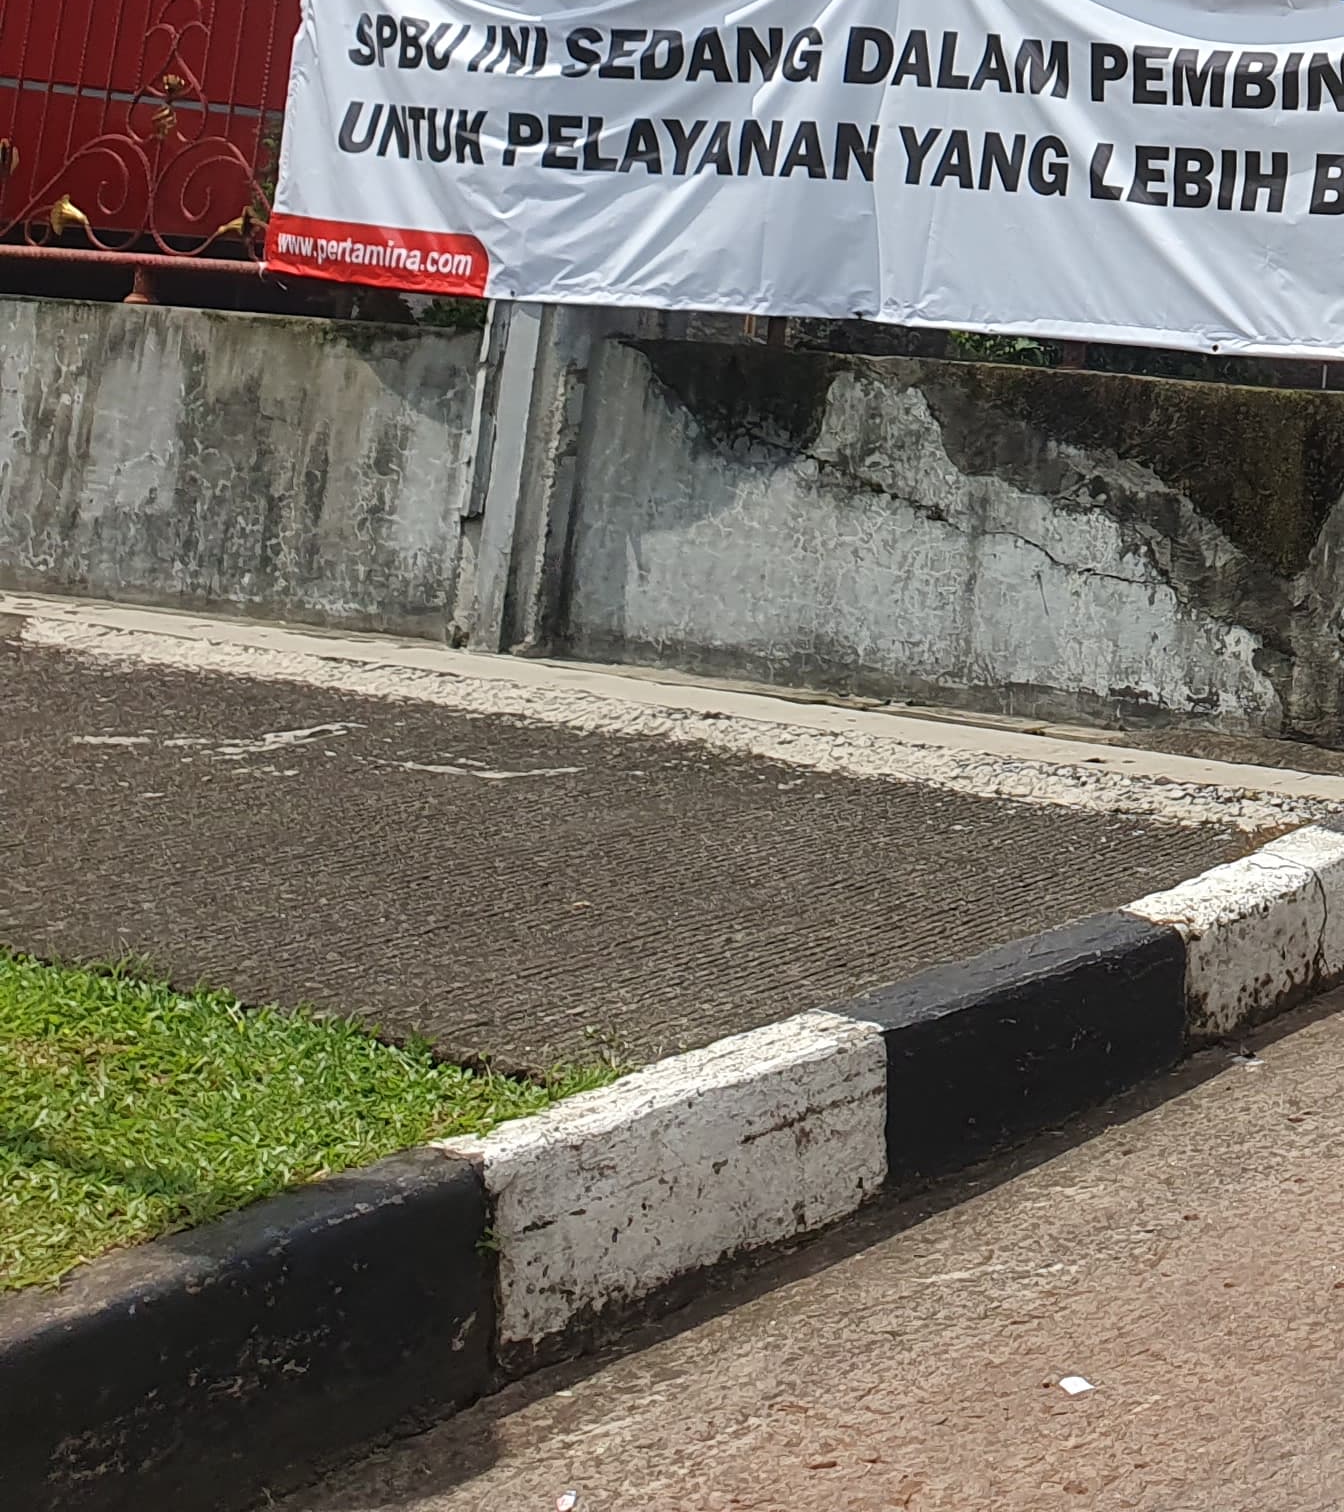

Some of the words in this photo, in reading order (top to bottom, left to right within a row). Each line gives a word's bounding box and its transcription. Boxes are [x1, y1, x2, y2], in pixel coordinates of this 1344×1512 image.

[348, 12, 470, 72] SPBU
[469, 24, 549, 76] INI
[559, 25, 824, 84] SEDANG
[842, 25, 1069, 99] DALAM
[337, 100, 486, 166] UNTUK
[502, 112, 880, 181] PELAYANAN
[899, 125, 1069, 198] YANG
[1089, 142, 1290, 215] LEBIH
[276, 232, 473, 277] www.pertamina.com
